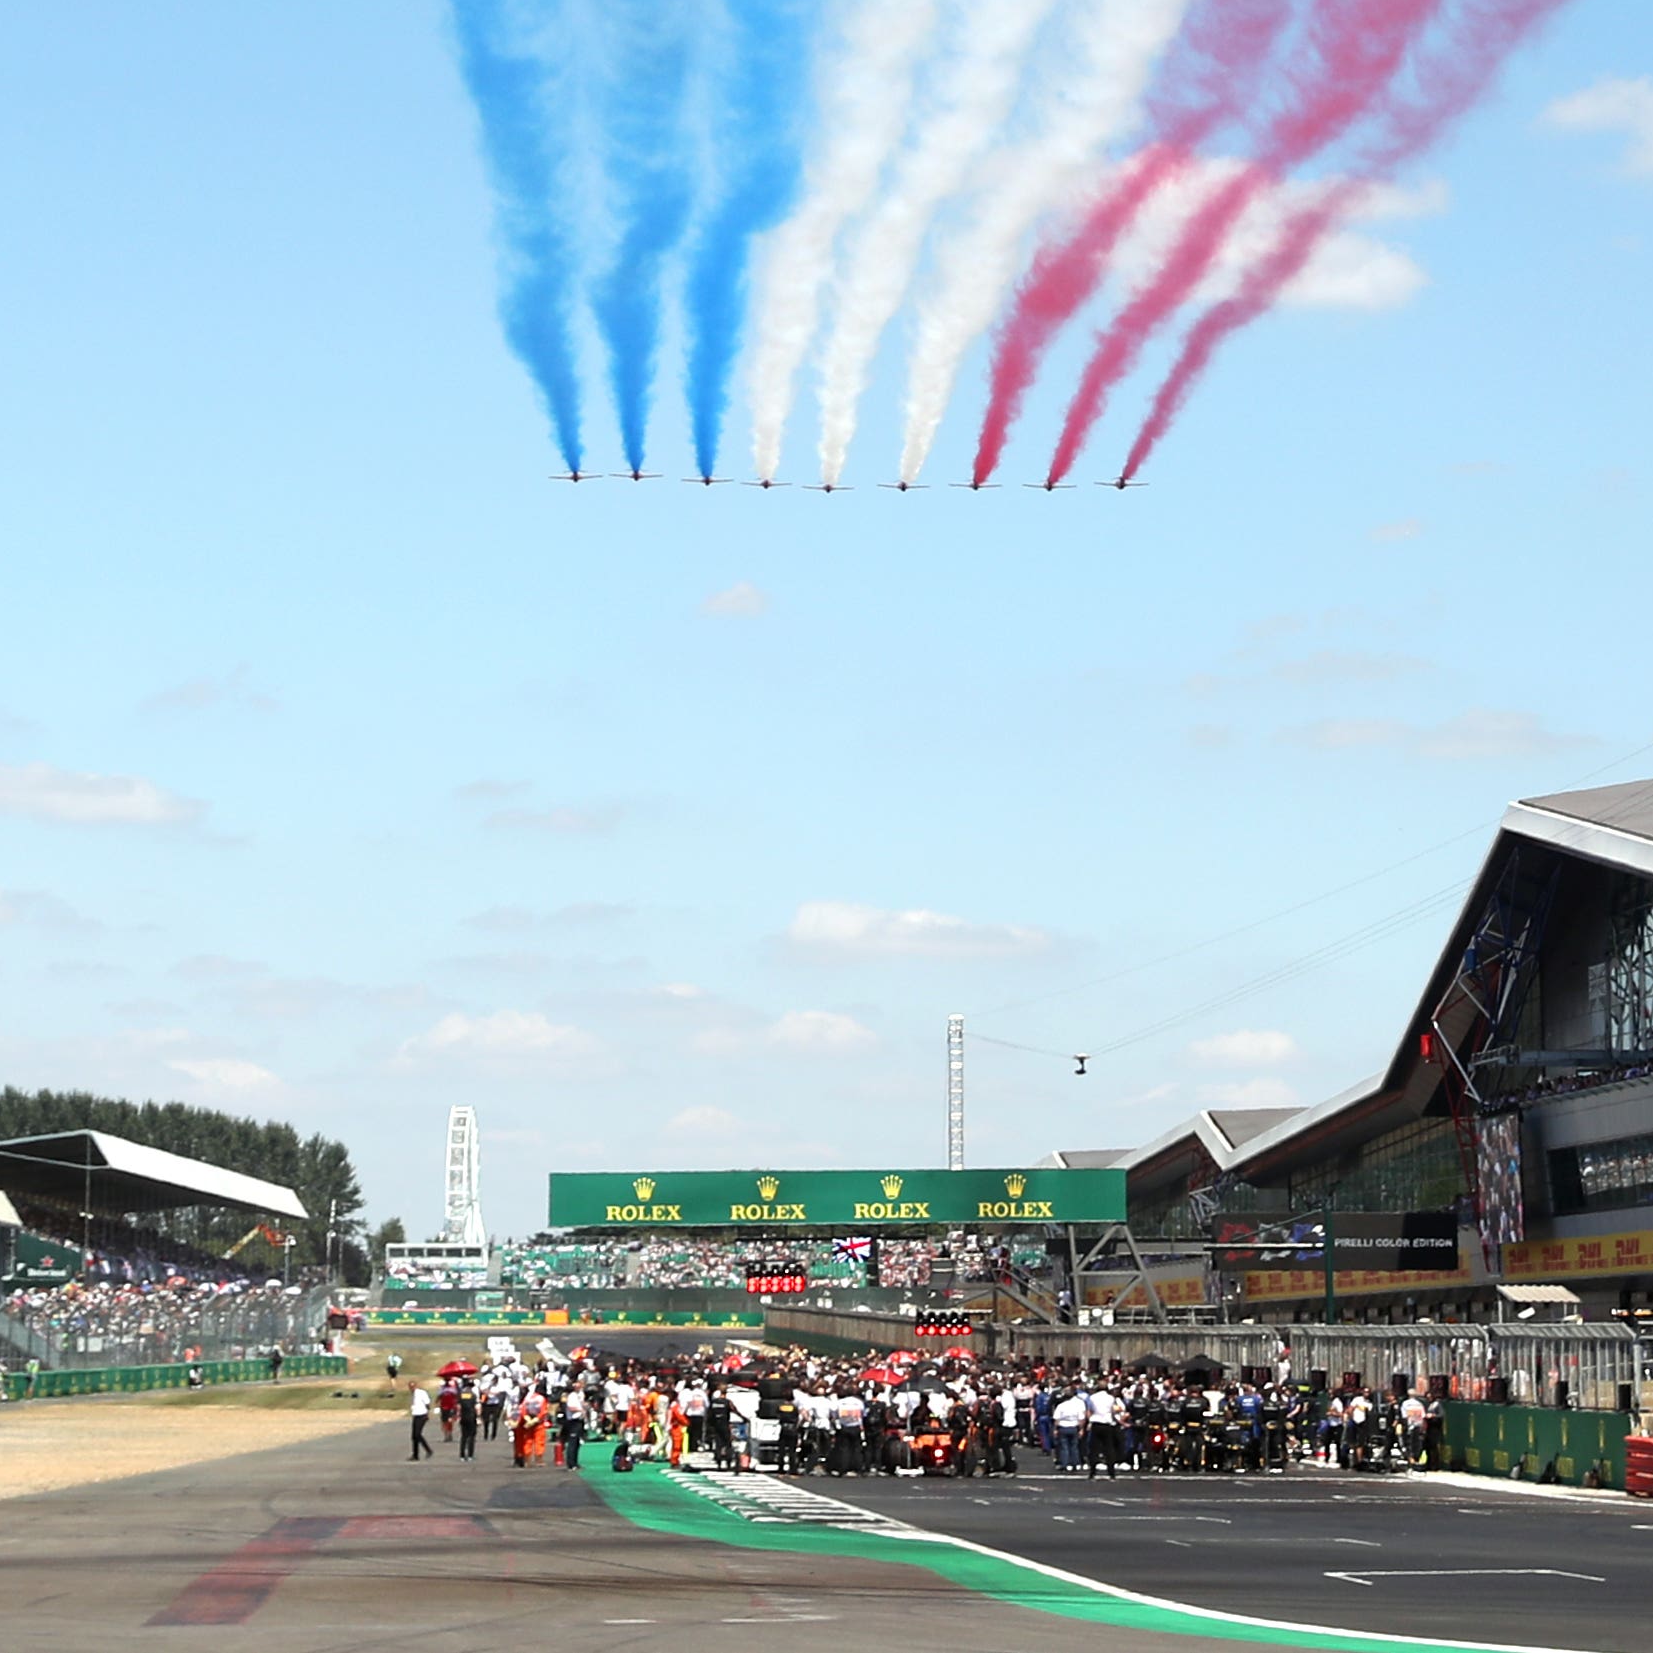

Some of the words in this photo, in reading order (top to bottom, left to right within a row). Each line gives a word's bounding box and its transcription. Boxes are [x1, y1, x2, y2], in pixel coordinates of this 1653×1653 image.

[606, 1204, 682, 1221] ROLEX
[730, 1204, 806, 1220] ROLEX
[854, 1203, 930, 1219] ROLEX
[978, 1202, 1054, 1218] ROLEX
[1334, 1237, 1373, 1248] PIRELLI
[1375, 1237, 1410, 1248] COLOR
[1412, 1237, 1453, 1248] EDITION
